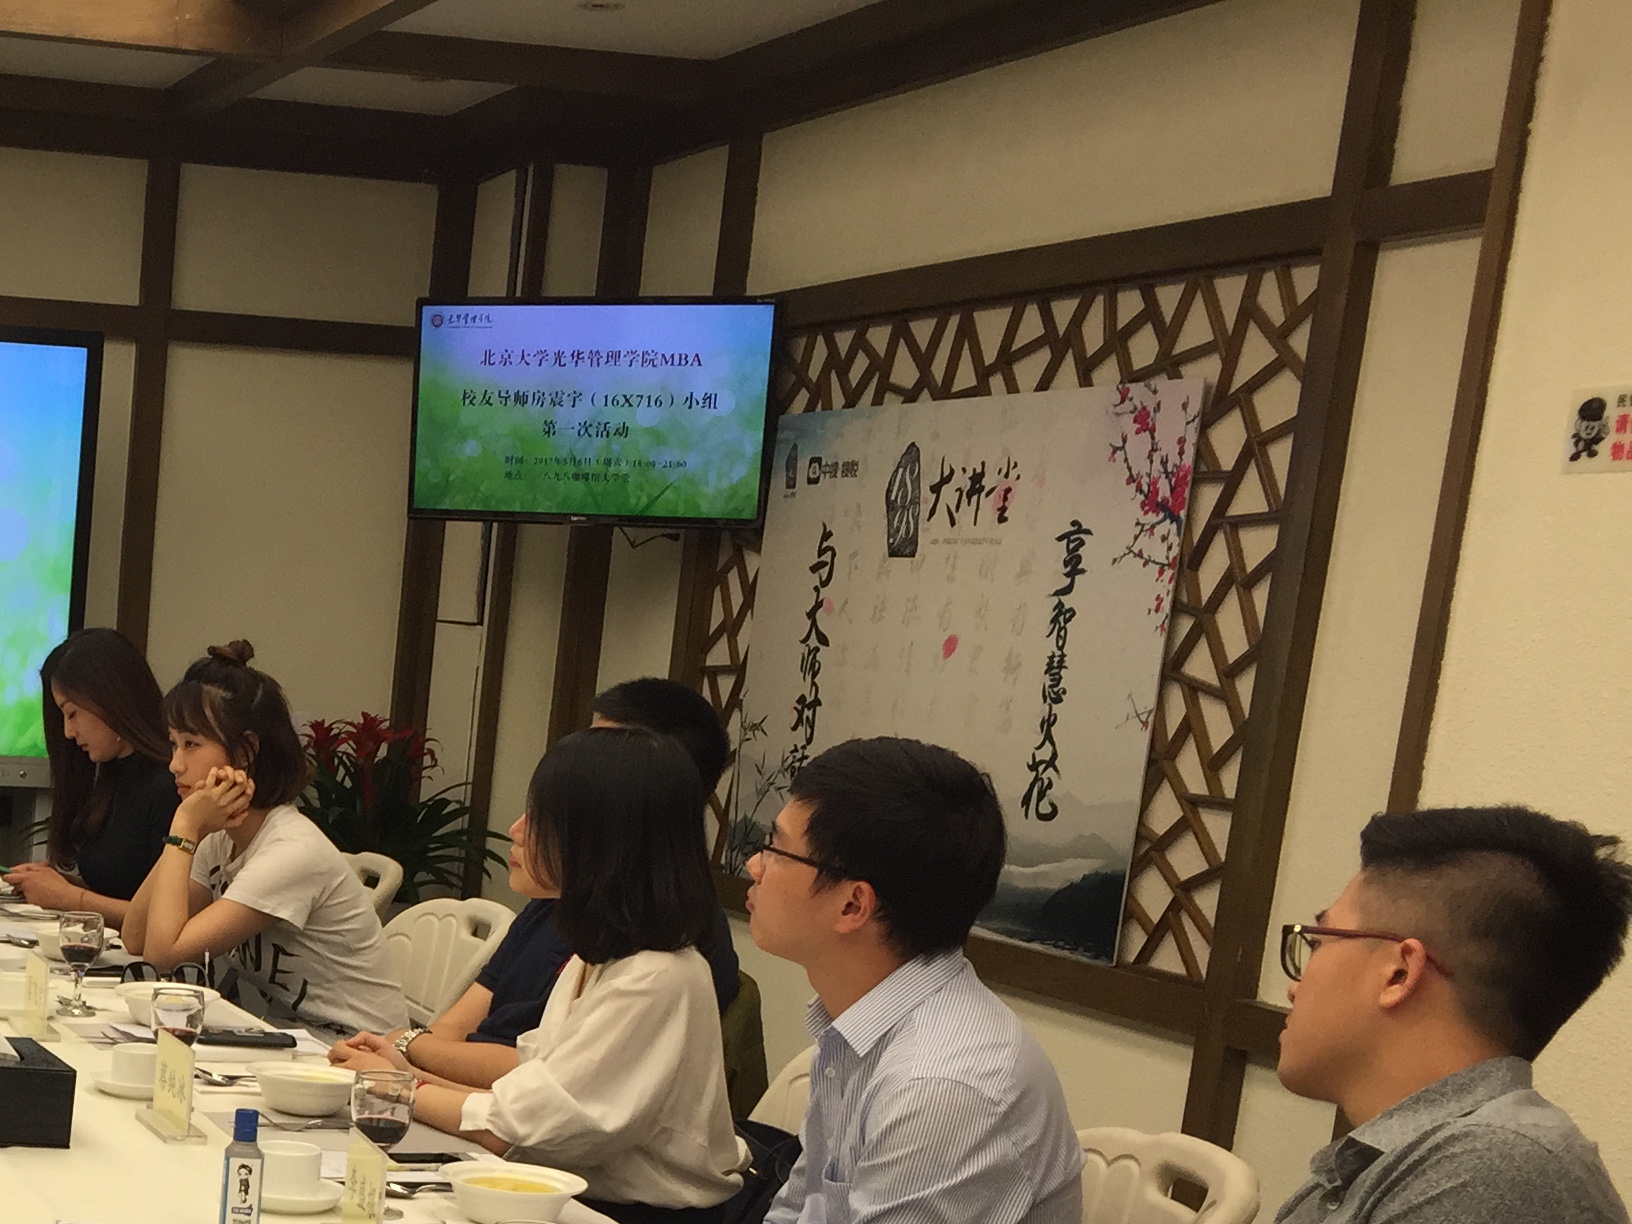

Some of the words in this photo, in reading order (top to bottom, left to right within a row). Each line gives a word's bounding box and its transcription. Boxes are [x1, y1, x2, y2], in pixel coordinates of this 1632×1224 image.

[480, 348, 703, 368] 北京大学光华管理学院MBA
[542, 420, 629, 439] 第一次活动
[926, 455, 1021, 528] 大讲堂
[1021, 520, 1094, 822] 享智慧火花
